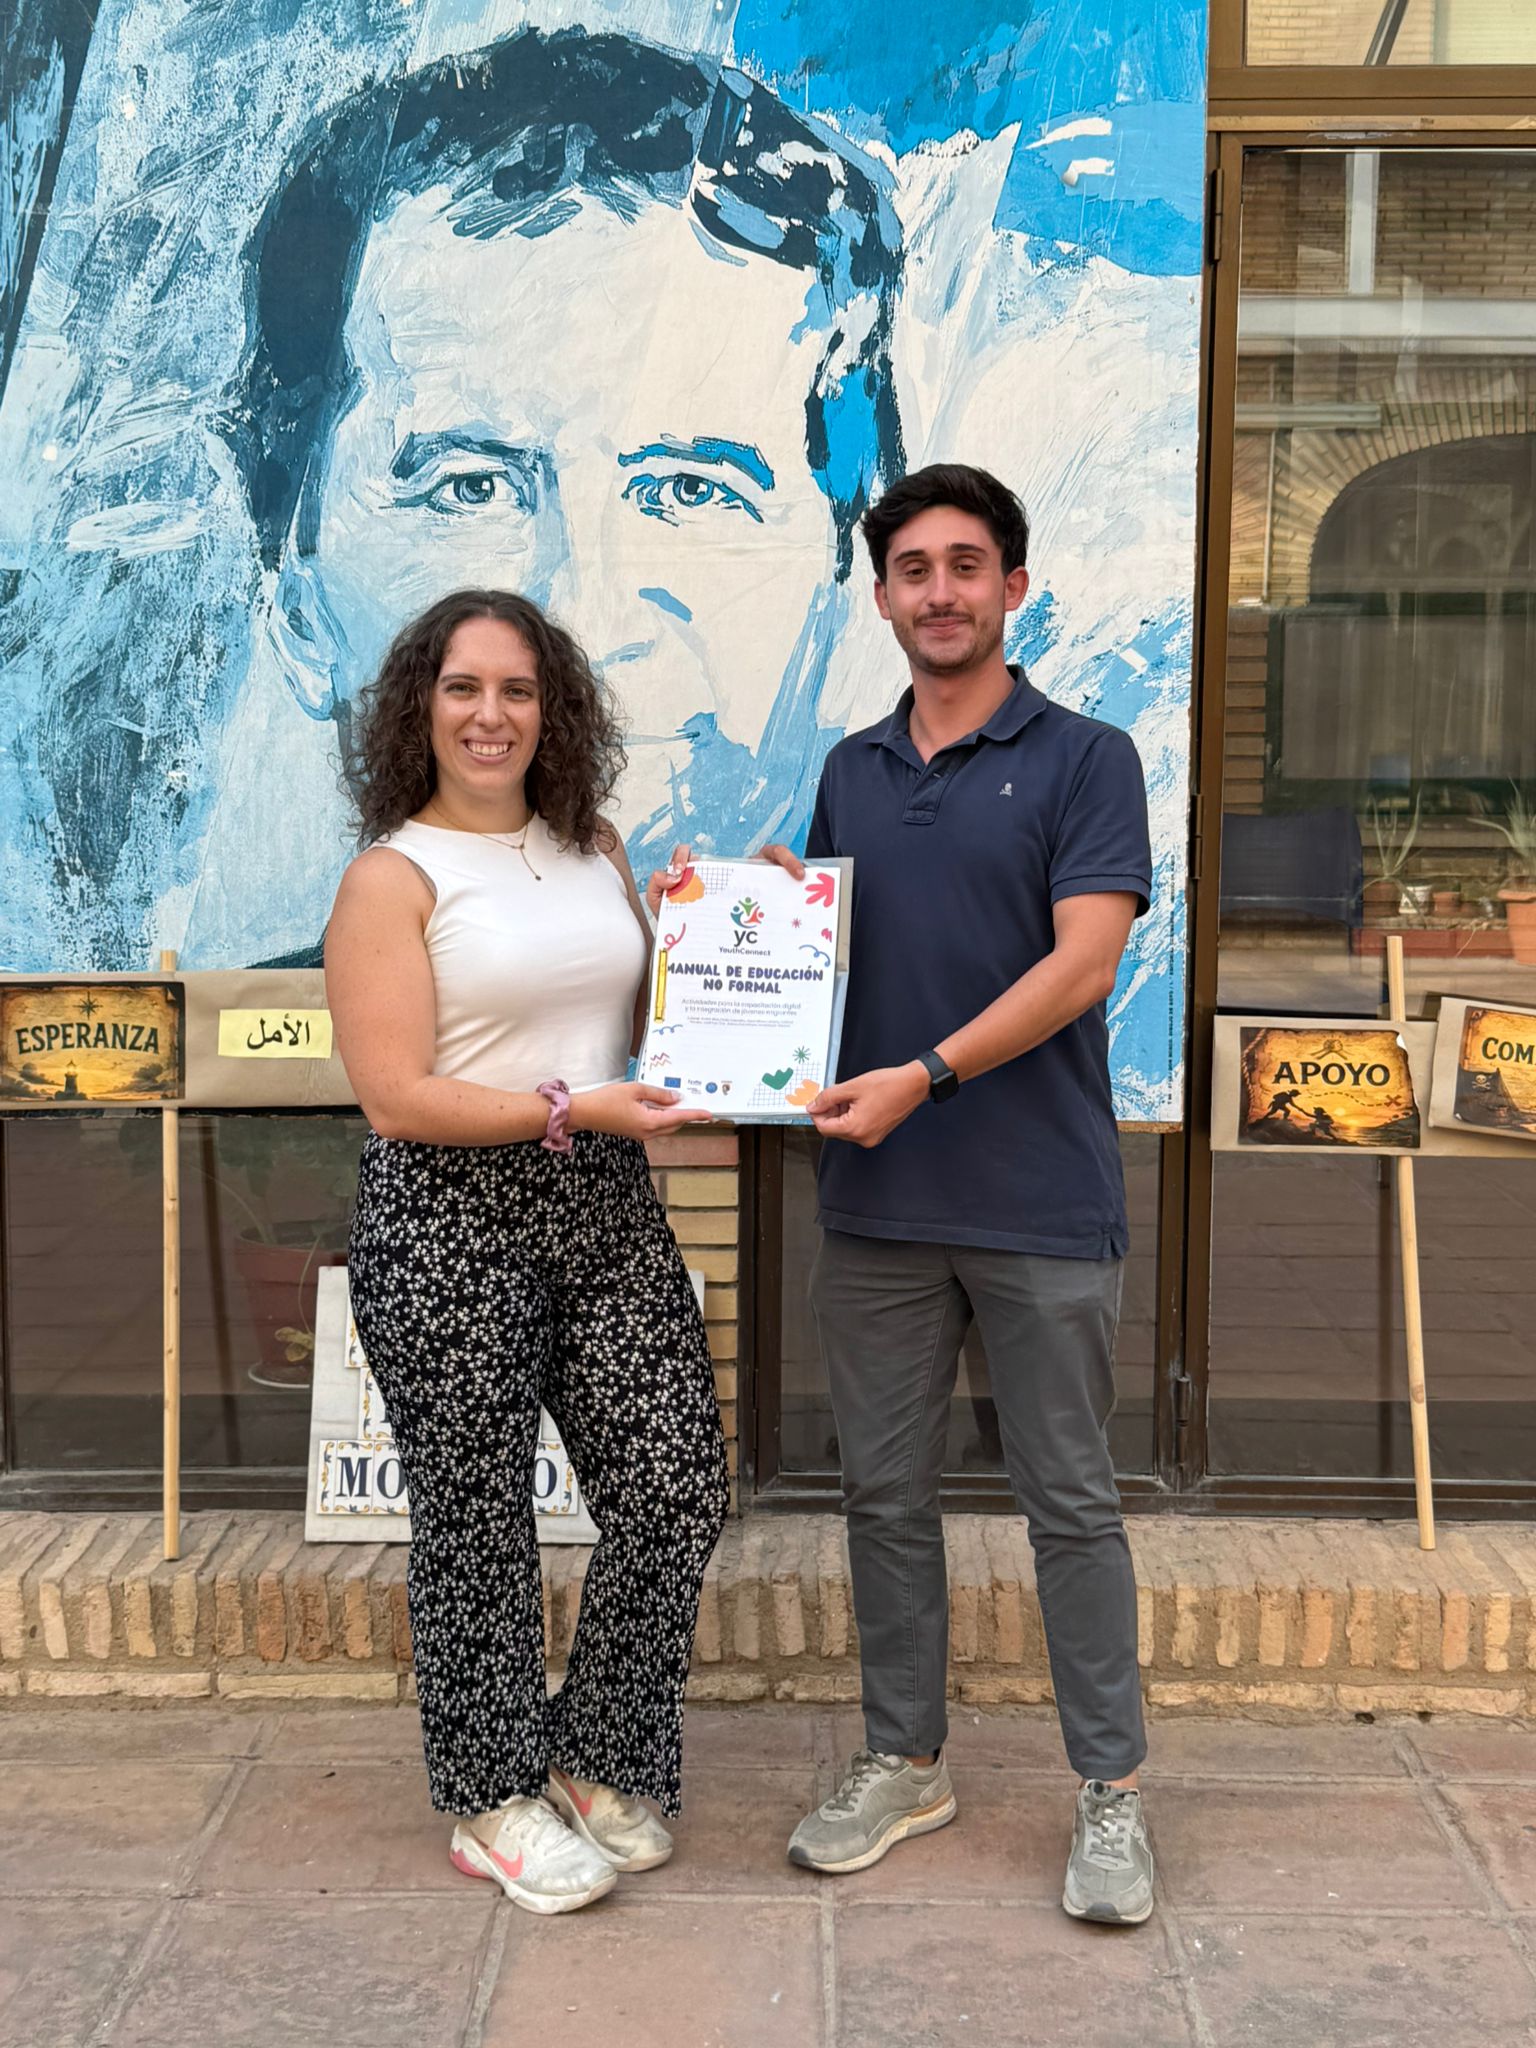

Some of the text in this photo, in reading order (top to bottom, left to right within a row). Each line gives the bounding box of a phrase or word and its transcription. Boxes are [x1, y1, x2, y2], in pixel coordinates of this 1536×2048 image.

[733, 929, 758, 948] yc
[726, 965, 742, 978] DE
[748, 965, 823, 981] EDUCACIÓN
[703, 978, 782, 995] NO FORMAL
[16, 1022, 160, 1055] ESPERANZA
[246, 1013, 310, 1050] الأمل
[1482, 1037, 1536, 1065] COM
[1272, 1061, 1390, 1086] APOYO
